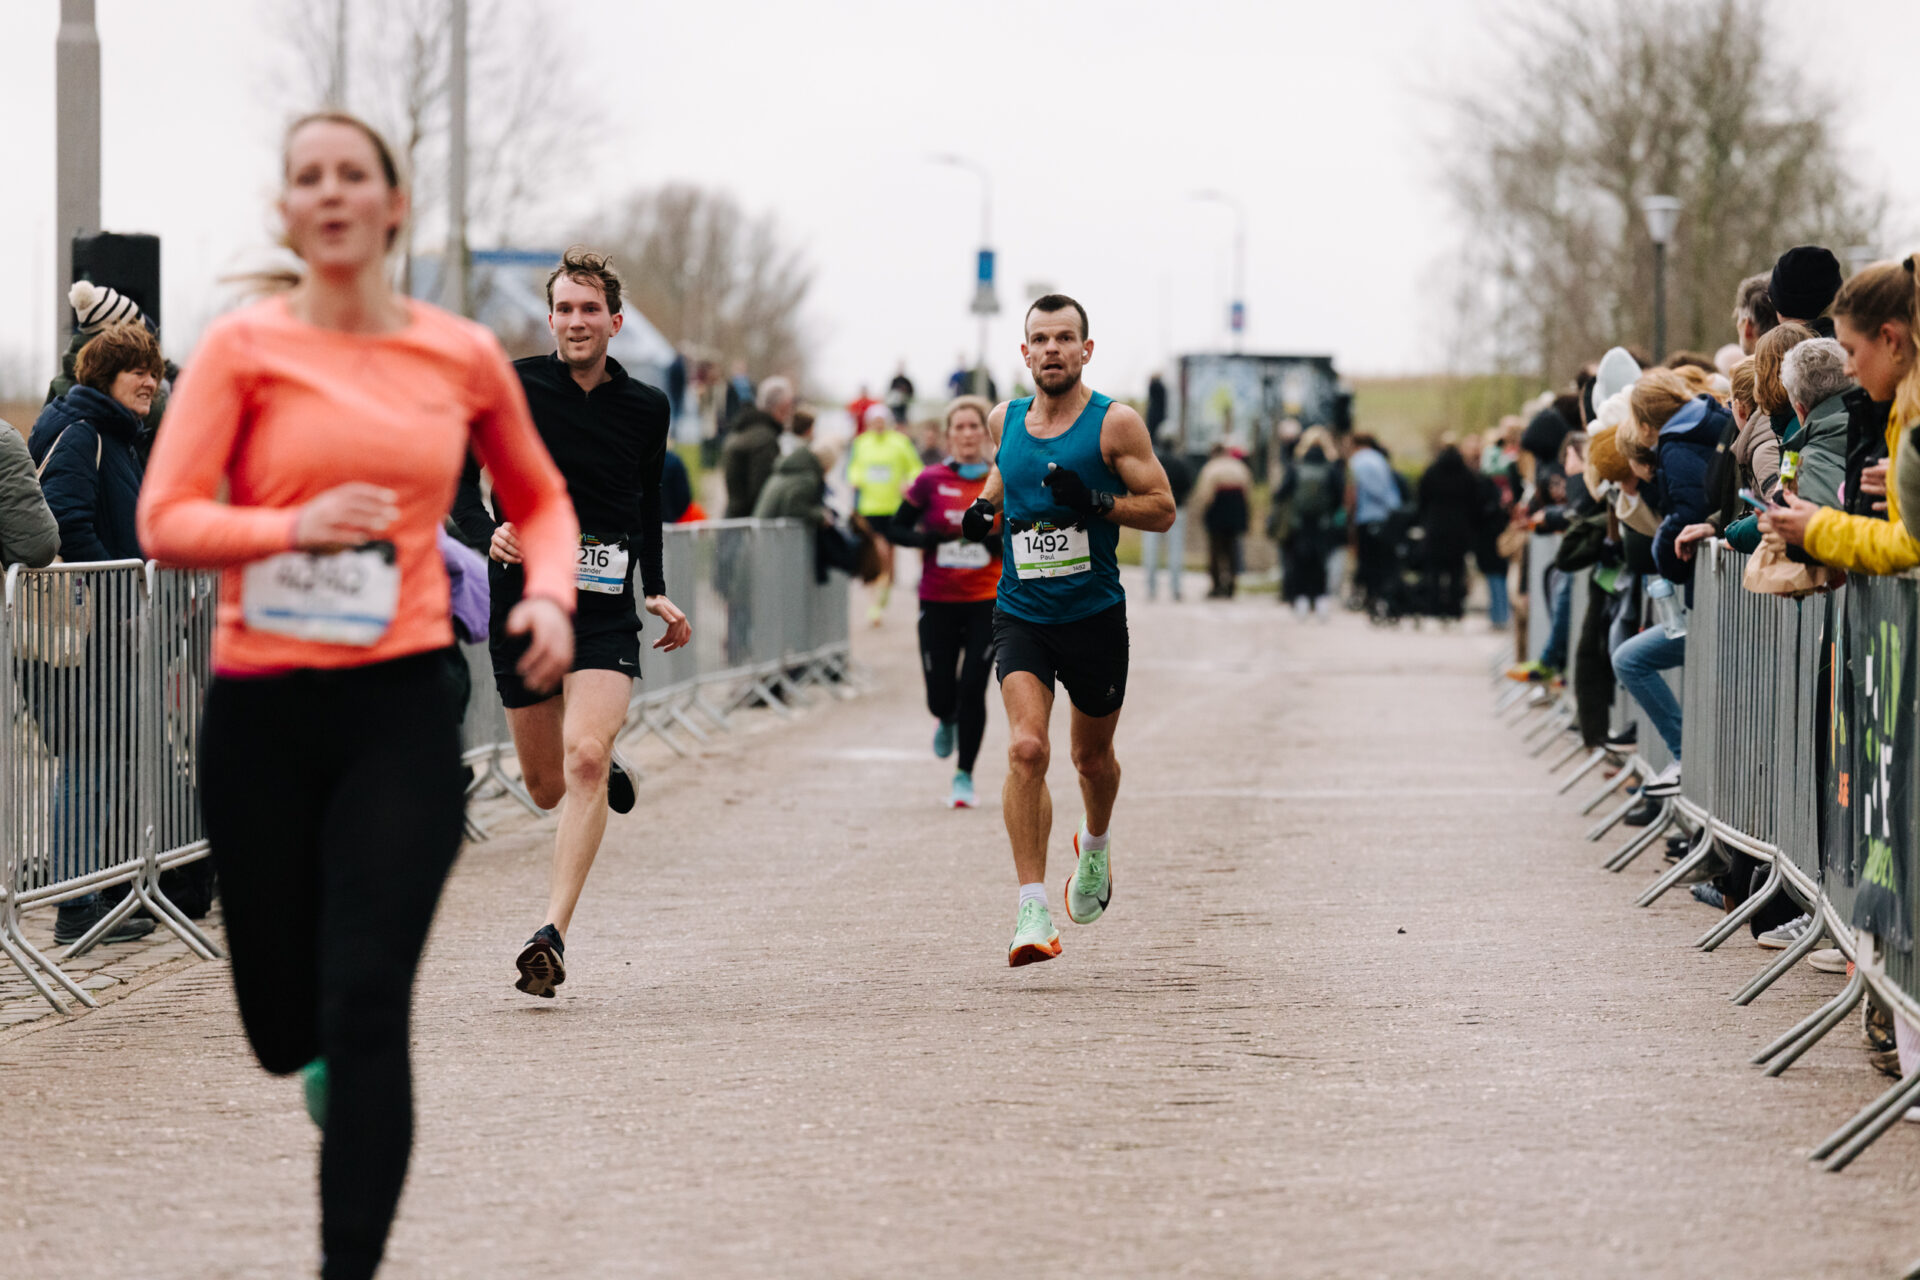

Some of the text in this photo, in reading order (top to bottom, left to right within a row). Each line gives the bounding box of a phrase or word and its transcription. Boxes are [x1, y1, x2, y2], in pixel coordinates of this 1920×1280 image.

[1025, 534, 1069, 553] 1492
[577, 548, 610, 567] 216
[576, 567, 602, 575] xander
